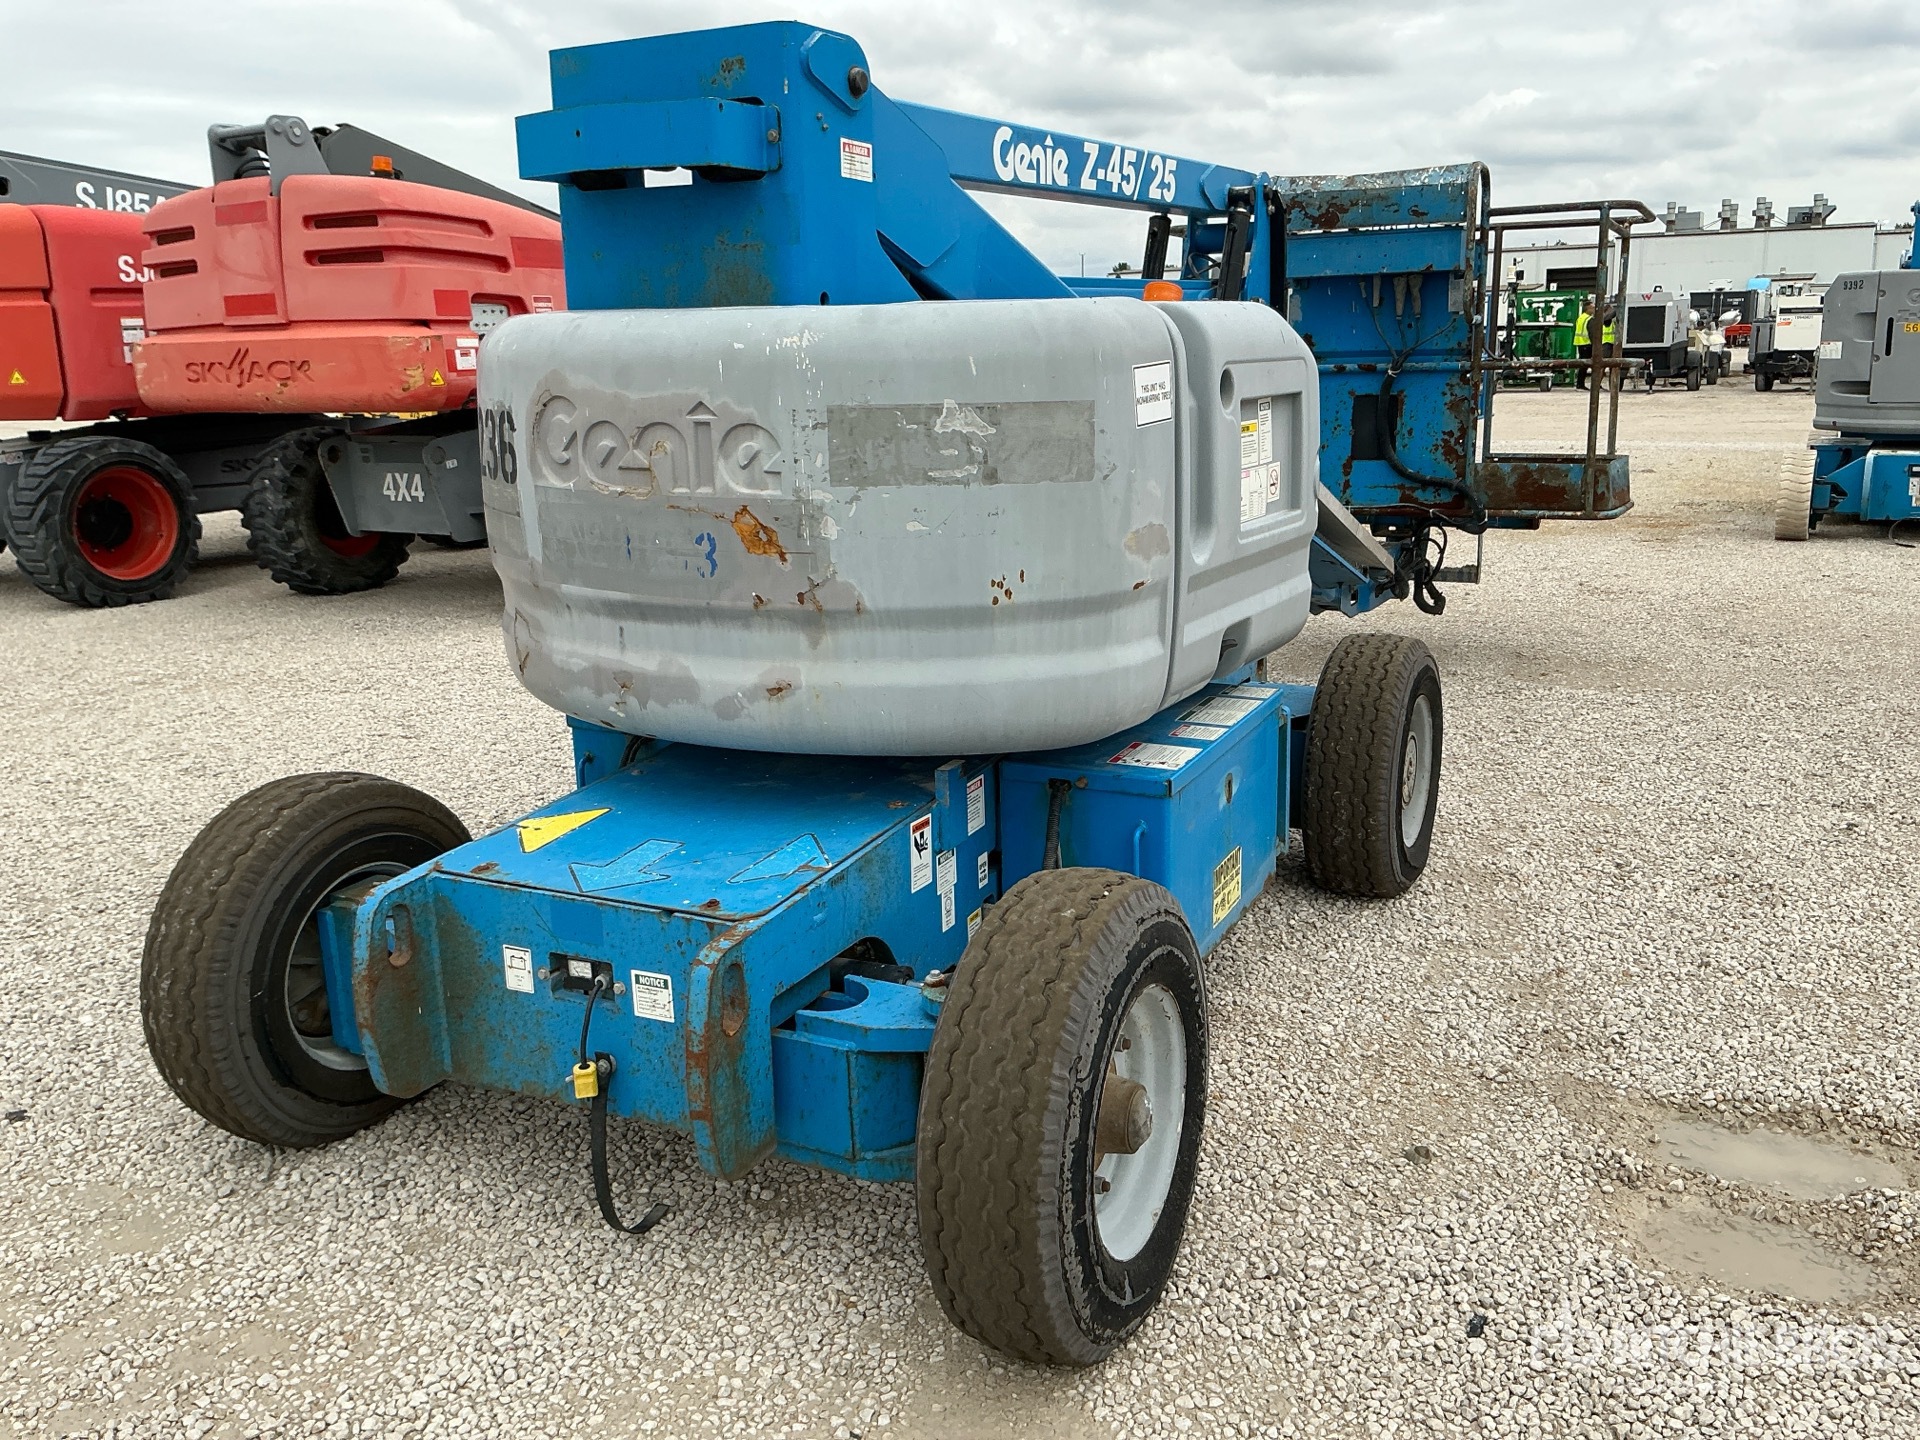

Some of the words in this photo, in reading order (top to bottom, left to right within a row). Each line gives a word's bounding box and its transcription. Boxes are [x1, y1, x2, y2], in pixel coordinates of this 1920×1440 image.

[993, 126, 1069, 187] Genie
[1080, 141, 1177, 203] Z-45/25
[1843, 280, 1865, 290] 9392
[185, 347, 315, 389] SKYJACK
[533, 394, 783, 498] Genie
[383, 472, 425, 503] 4X4
[638, 975, 665, 988] NOTICE
